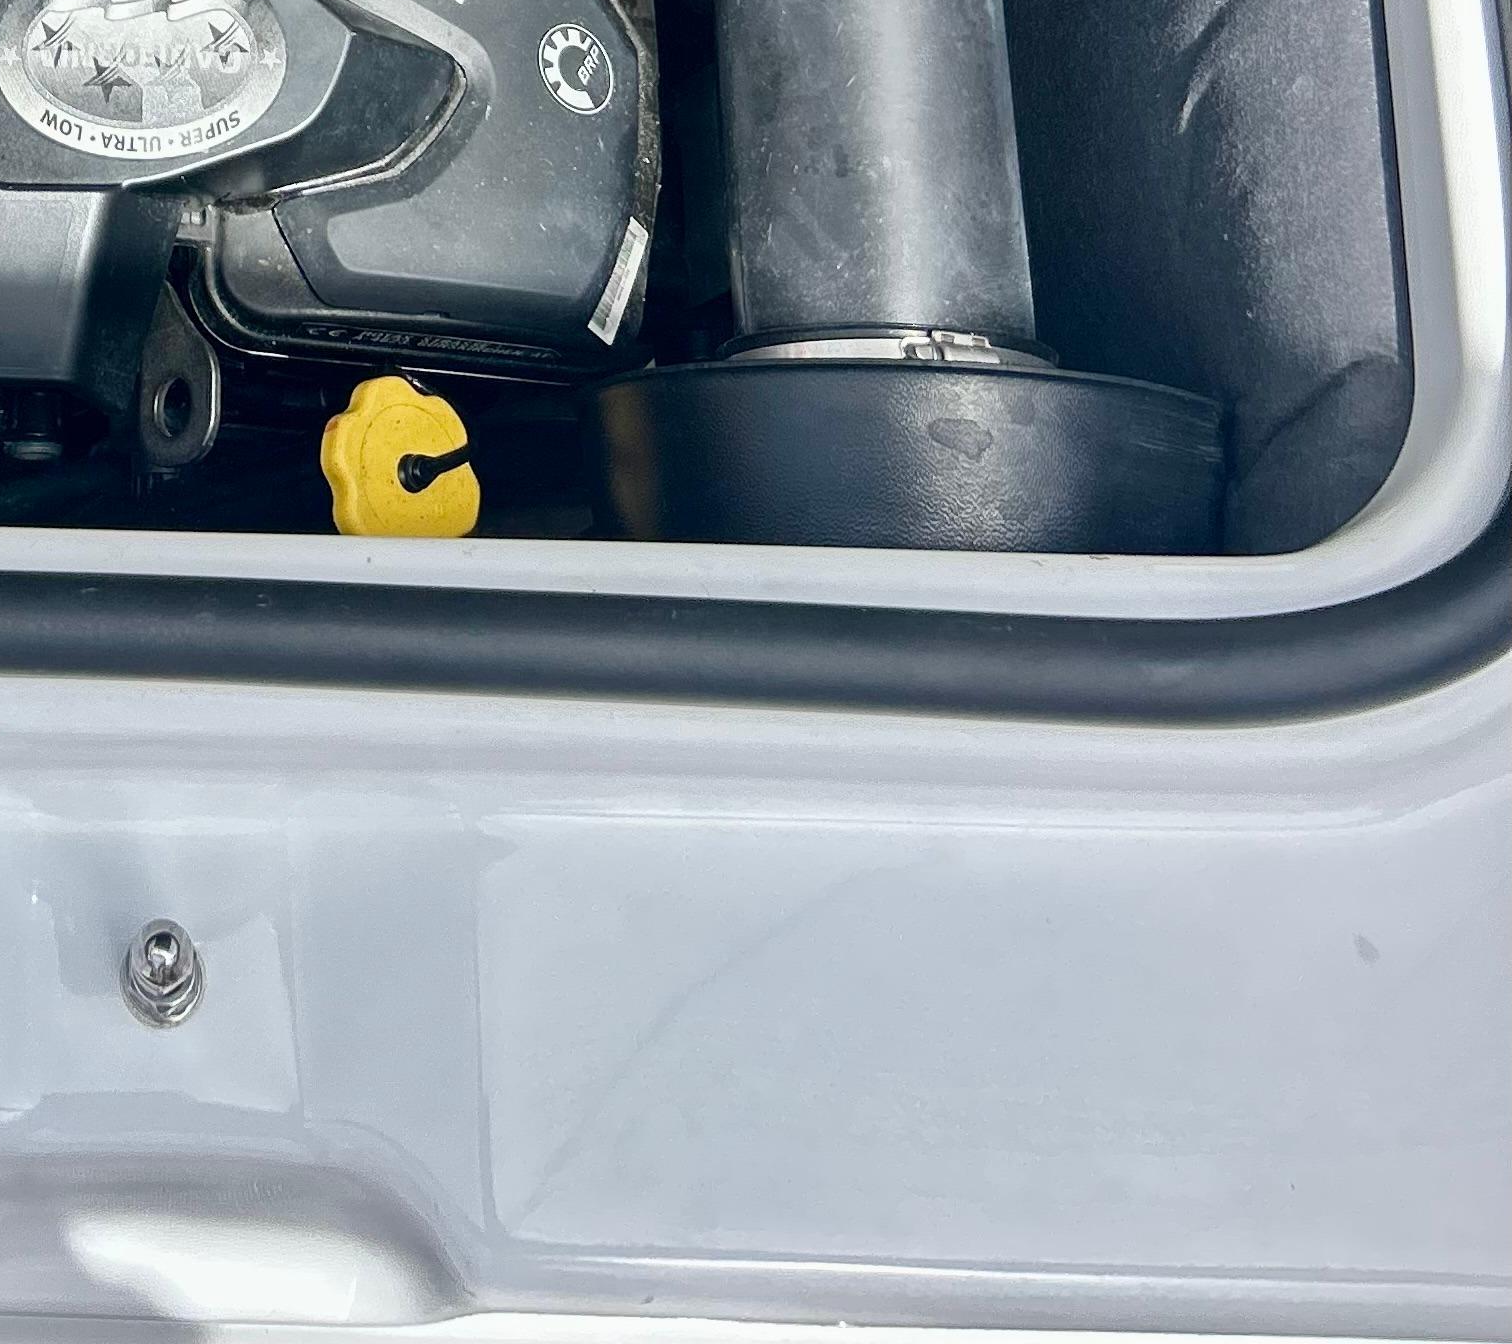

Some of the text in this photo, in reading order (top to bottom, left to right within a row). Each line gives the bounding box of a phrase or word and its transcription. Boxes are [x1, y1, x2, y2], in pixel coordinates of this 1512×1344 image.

[577, 46, 604, 85] BRP
[40, 109, 241, 152] SUPER ULTRA LOW
